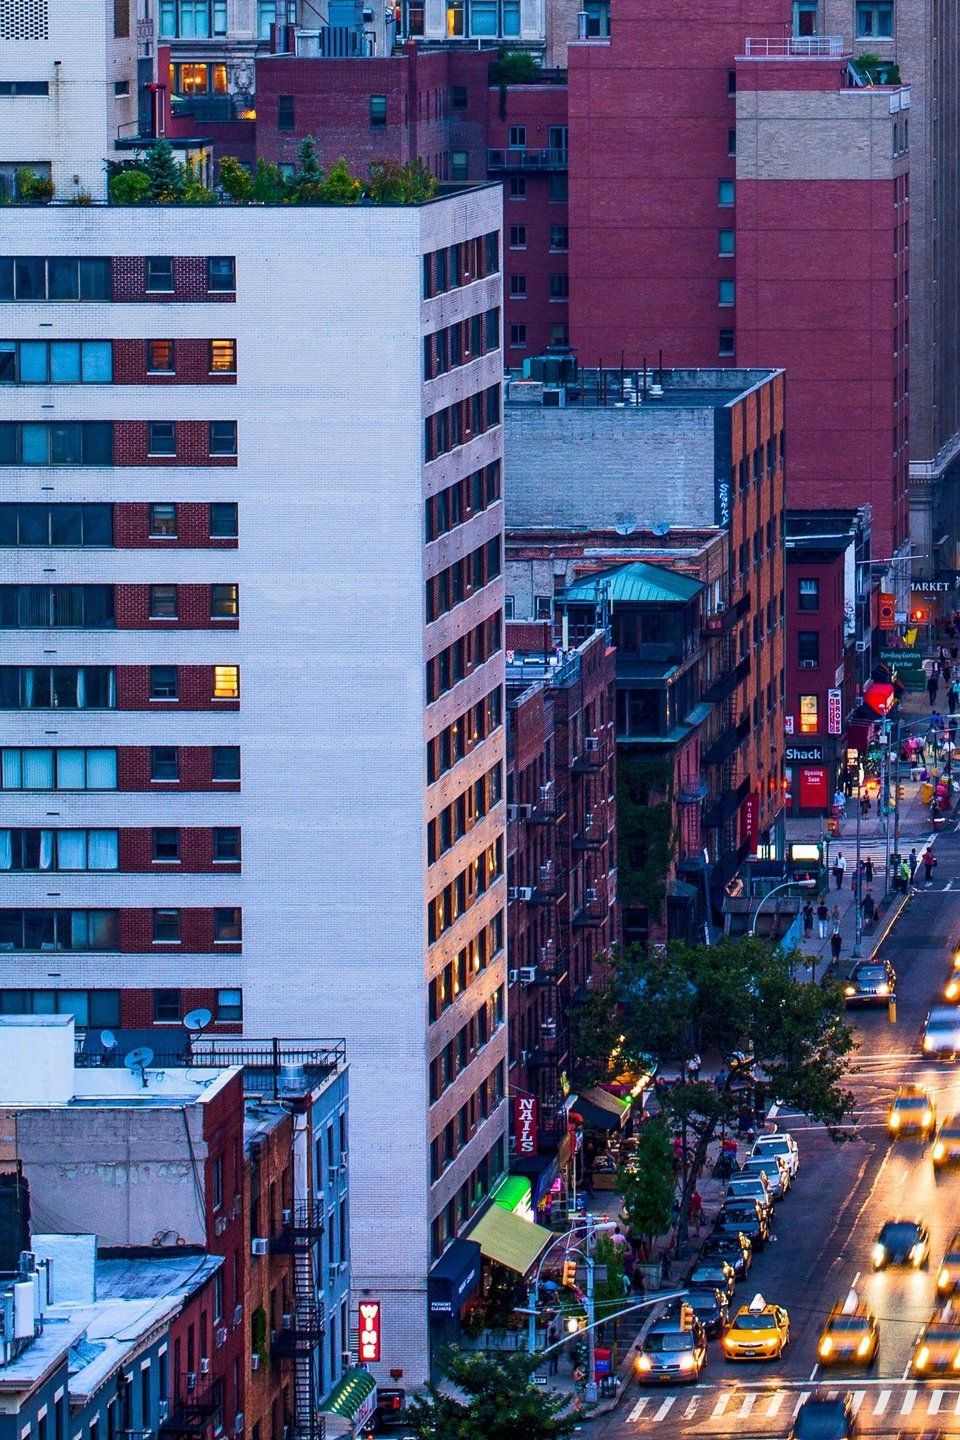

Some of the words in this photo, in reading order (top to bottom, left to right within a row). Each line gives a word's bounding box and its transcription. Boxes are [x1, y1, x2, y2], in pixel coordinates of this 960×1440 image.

[786, 748, 821, 759] Shack
[519, 1099, 534, 1152] NAILS
[360, 1305, 378, 1359] WINE
